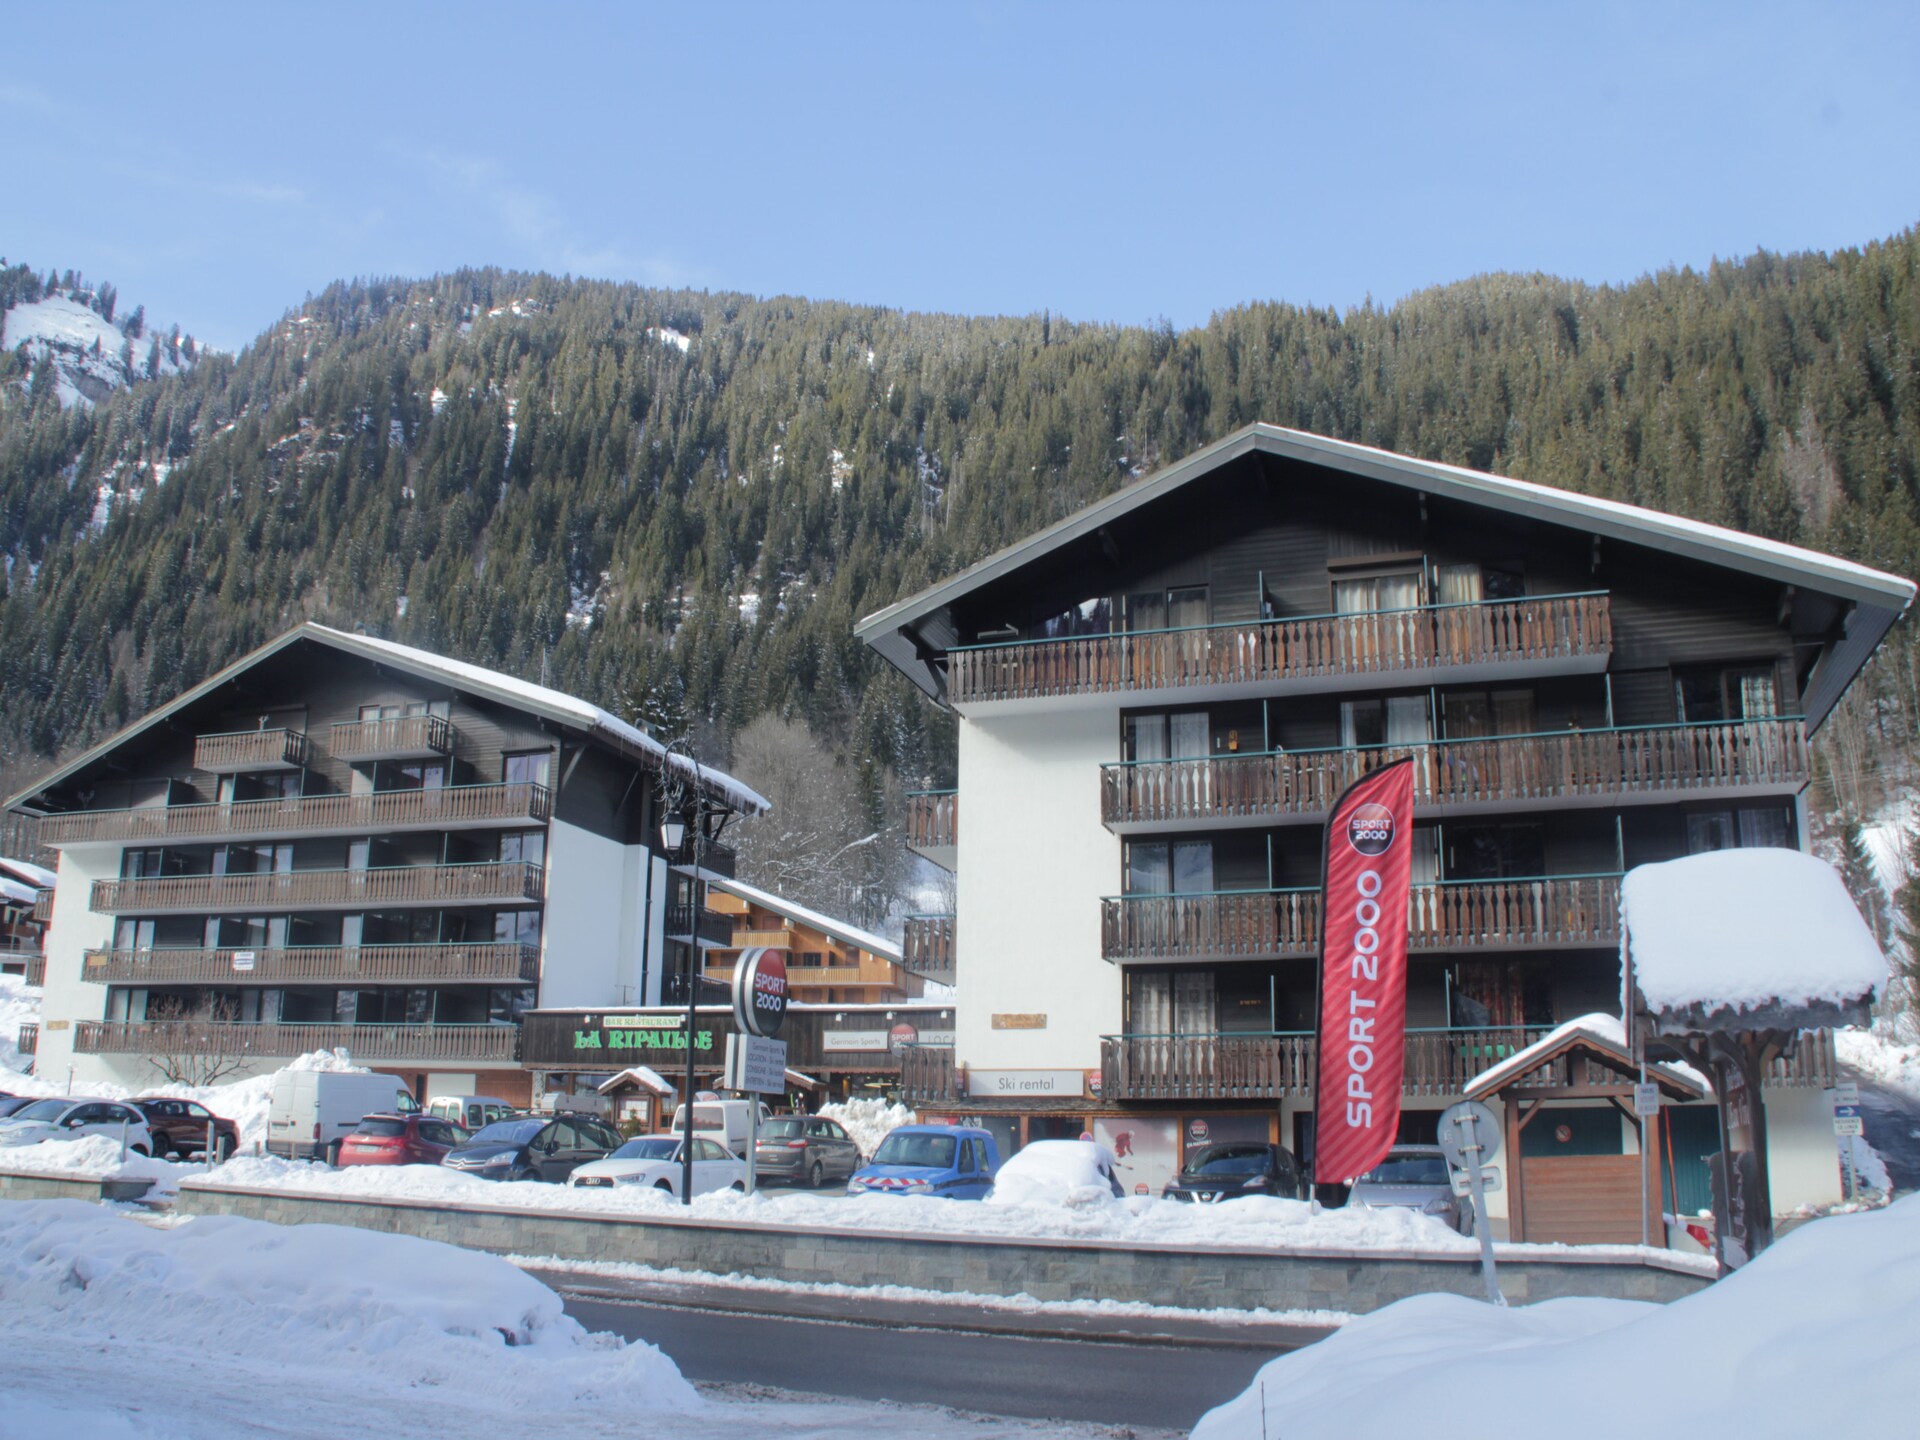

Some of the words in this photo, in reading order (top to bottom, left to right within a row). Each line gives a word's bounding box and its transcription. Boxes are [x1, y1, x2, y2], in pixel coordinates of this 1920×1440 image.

[1352, 819, 1391, 829] SPORT
[1355, 829, 1388, 840] 2000
[1352, 870, 1382, 981] 2000
[755, 973, 785, 993] SPORT
[757, 992, 781, 1012] 2000
[605, 1018, 622, 1026] BAR
[624, 1018, 679, 1026] RESTAURANT
[574, 1030, 602, 1049] LA
[891, 1033, 914, 1041] SPORT
[1347, 990, 1376, 1128] SPORT
[998, 1077, 1016, 1090] Ski
[1020, 1077, 1055, 1090] rental
